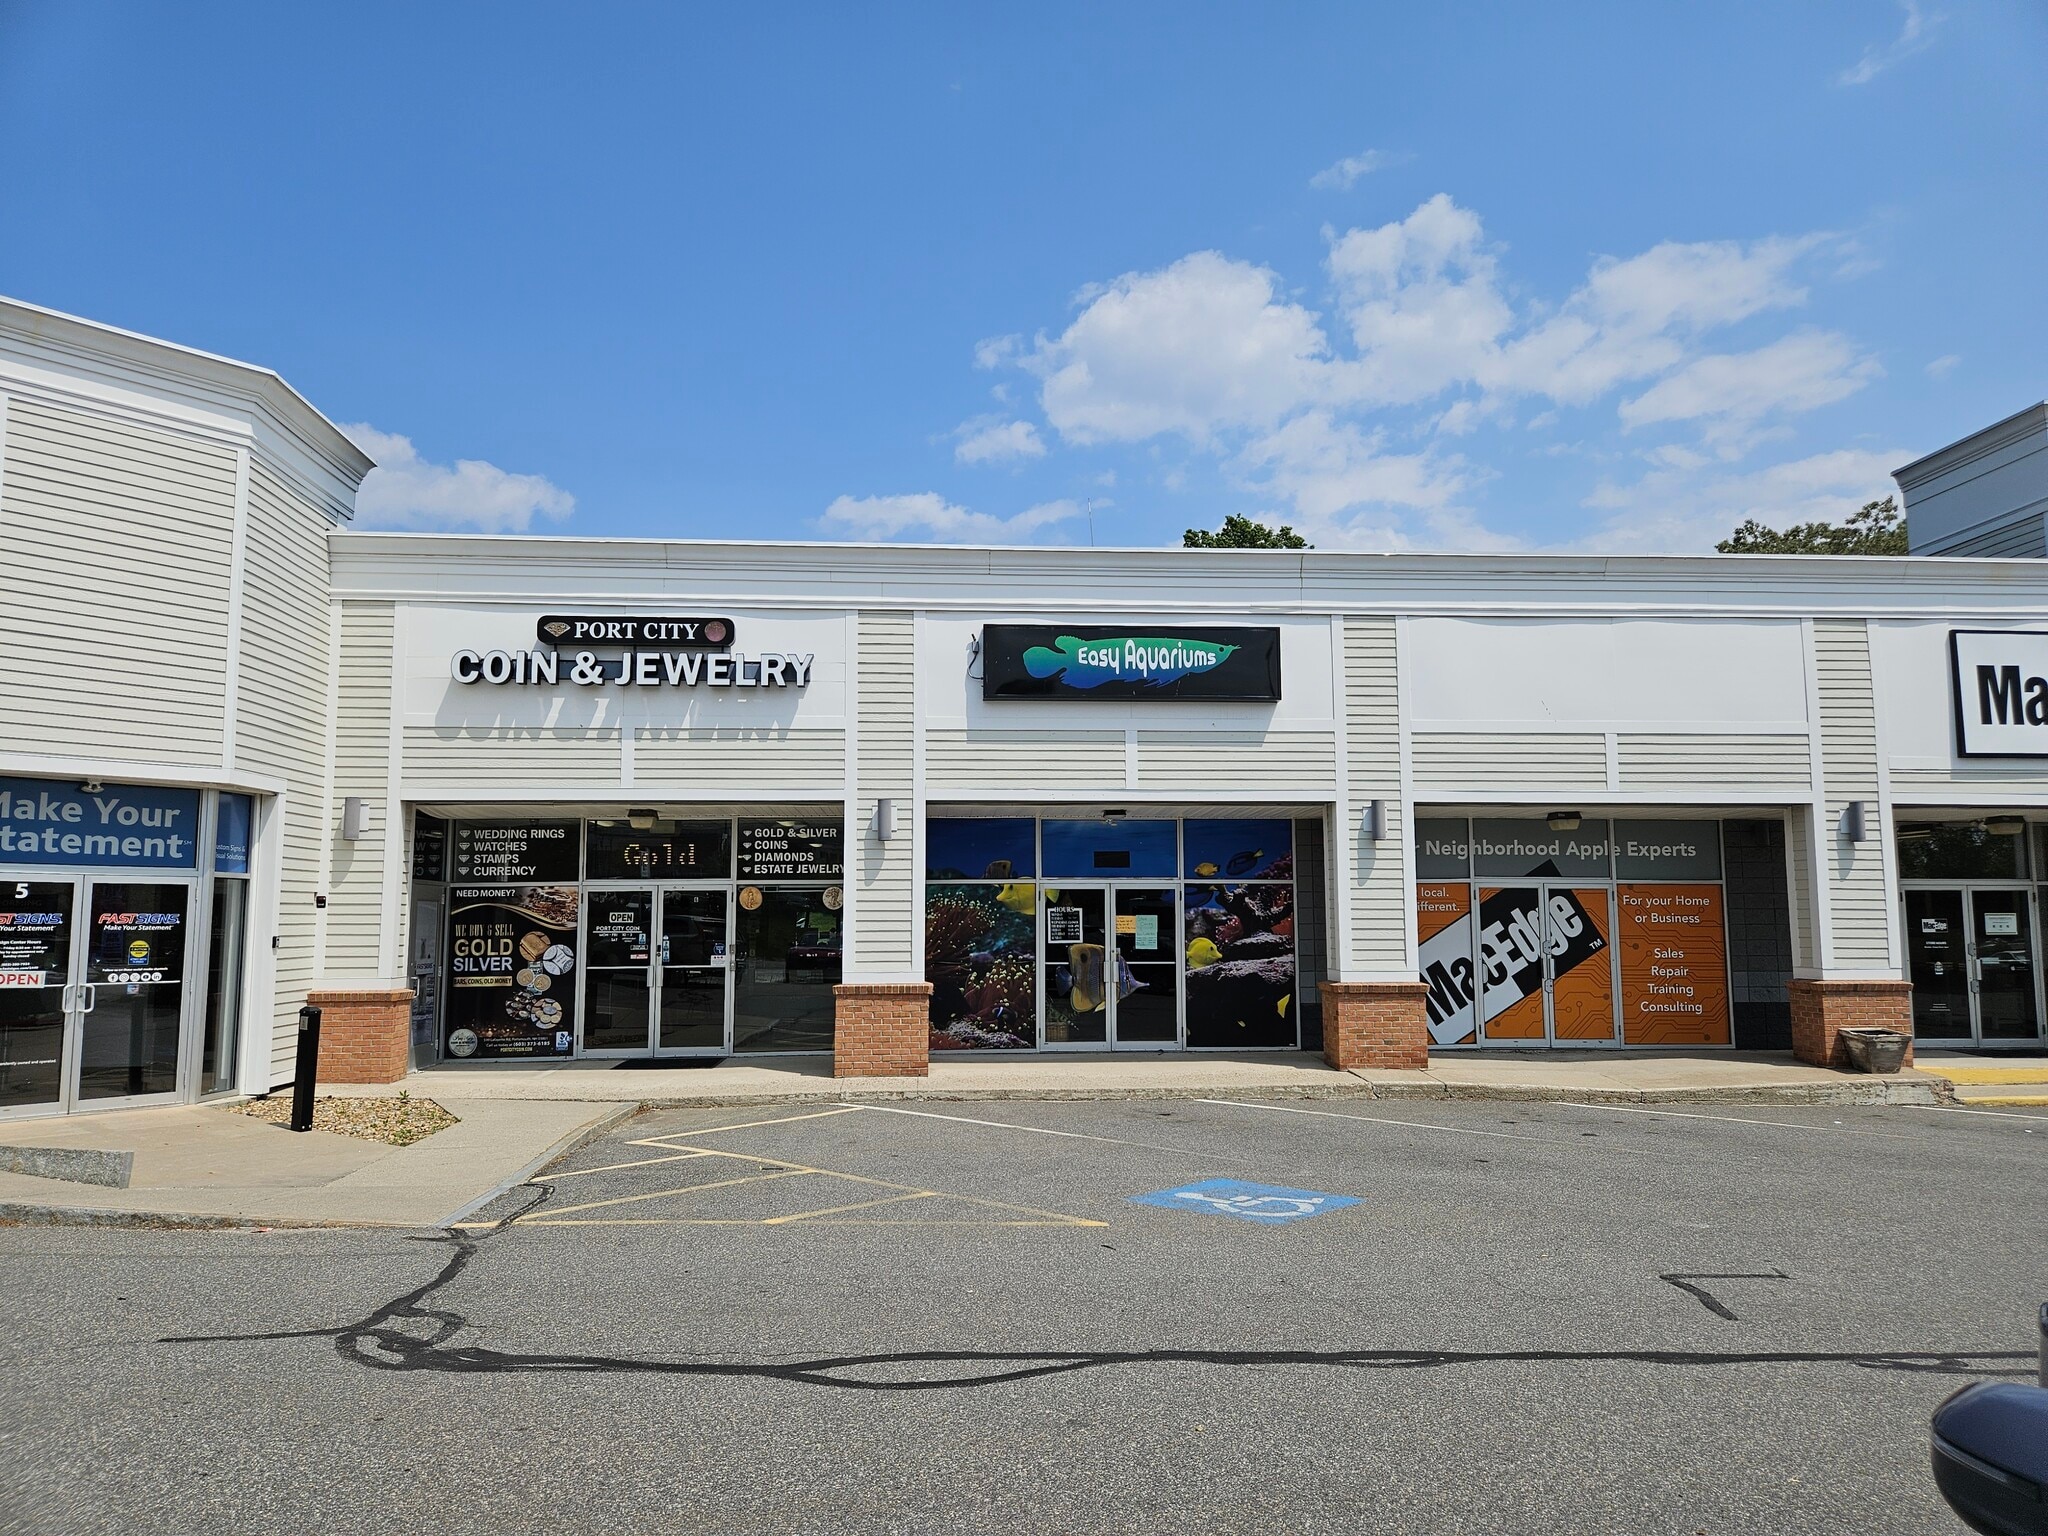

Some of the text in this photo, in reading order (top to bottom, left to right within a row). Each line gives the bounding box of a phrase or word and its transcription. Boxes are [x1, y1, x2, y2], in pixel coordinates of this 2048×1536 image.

[574, 622, 700, 640] PORT CITY
[1078, 639, 1217, 678] Easy Aquariums
[451, 650, 815, 688] COIN & JEWELRY
[92, 797, 181, 827] Your
[474, 829, 565, 839] WEDDING RINGS
[754, 828, 837, 838] GOLD & SILVER
[0, 825, 184, 859] tatement
[474, 842, 527, 851] WATCHES
[754, 840, 788, 850] COINS
[624, 844, 696, 865] Gold
[1425, 839, 1697, 861] Neighborhood Apple Experts
[473, 854, 519, 864] STAMPS
[754, 852, 814, 862] DIAMONDS
[473, 866, 536, 876] CURRENCY
[754, 864, 793, 874] ESTATE
[15, 883, 28, 899] 5
[456, 889, 516, 897] NEED MONEY?
[1421, 887, 1449, 897] local.
[1417, 901, 1460, 911] ifferent.
[1623, 895, 1710, 908] For your Home
[0, 912, 61, 925] STSIGNS
[98, 913, 179, 924] FASTSIGNS
[610, 913, 633, 922] OPEN
[1635, 913, 1700, 923] or Business
[455, 924, 466, 937] WE
[470, 924, 484, 937] BUY
[495, 924, 514, 937] SELL
[1923, 921, 1948, 931] MacEdge
[454, 939, 514, 957] GOLD
[1654, 948, 1684, 959] Sales
[453, 957, 513, 972] SILVER
[1419, 895, 1584, 1027] MacEdge
[1651, 966, 1689, 979] Repair
[467, 977, 482, 985] COINS,
[1647, 983, 1694, 997] Training
[1640, 1001, 1703, 1015] Consulting
